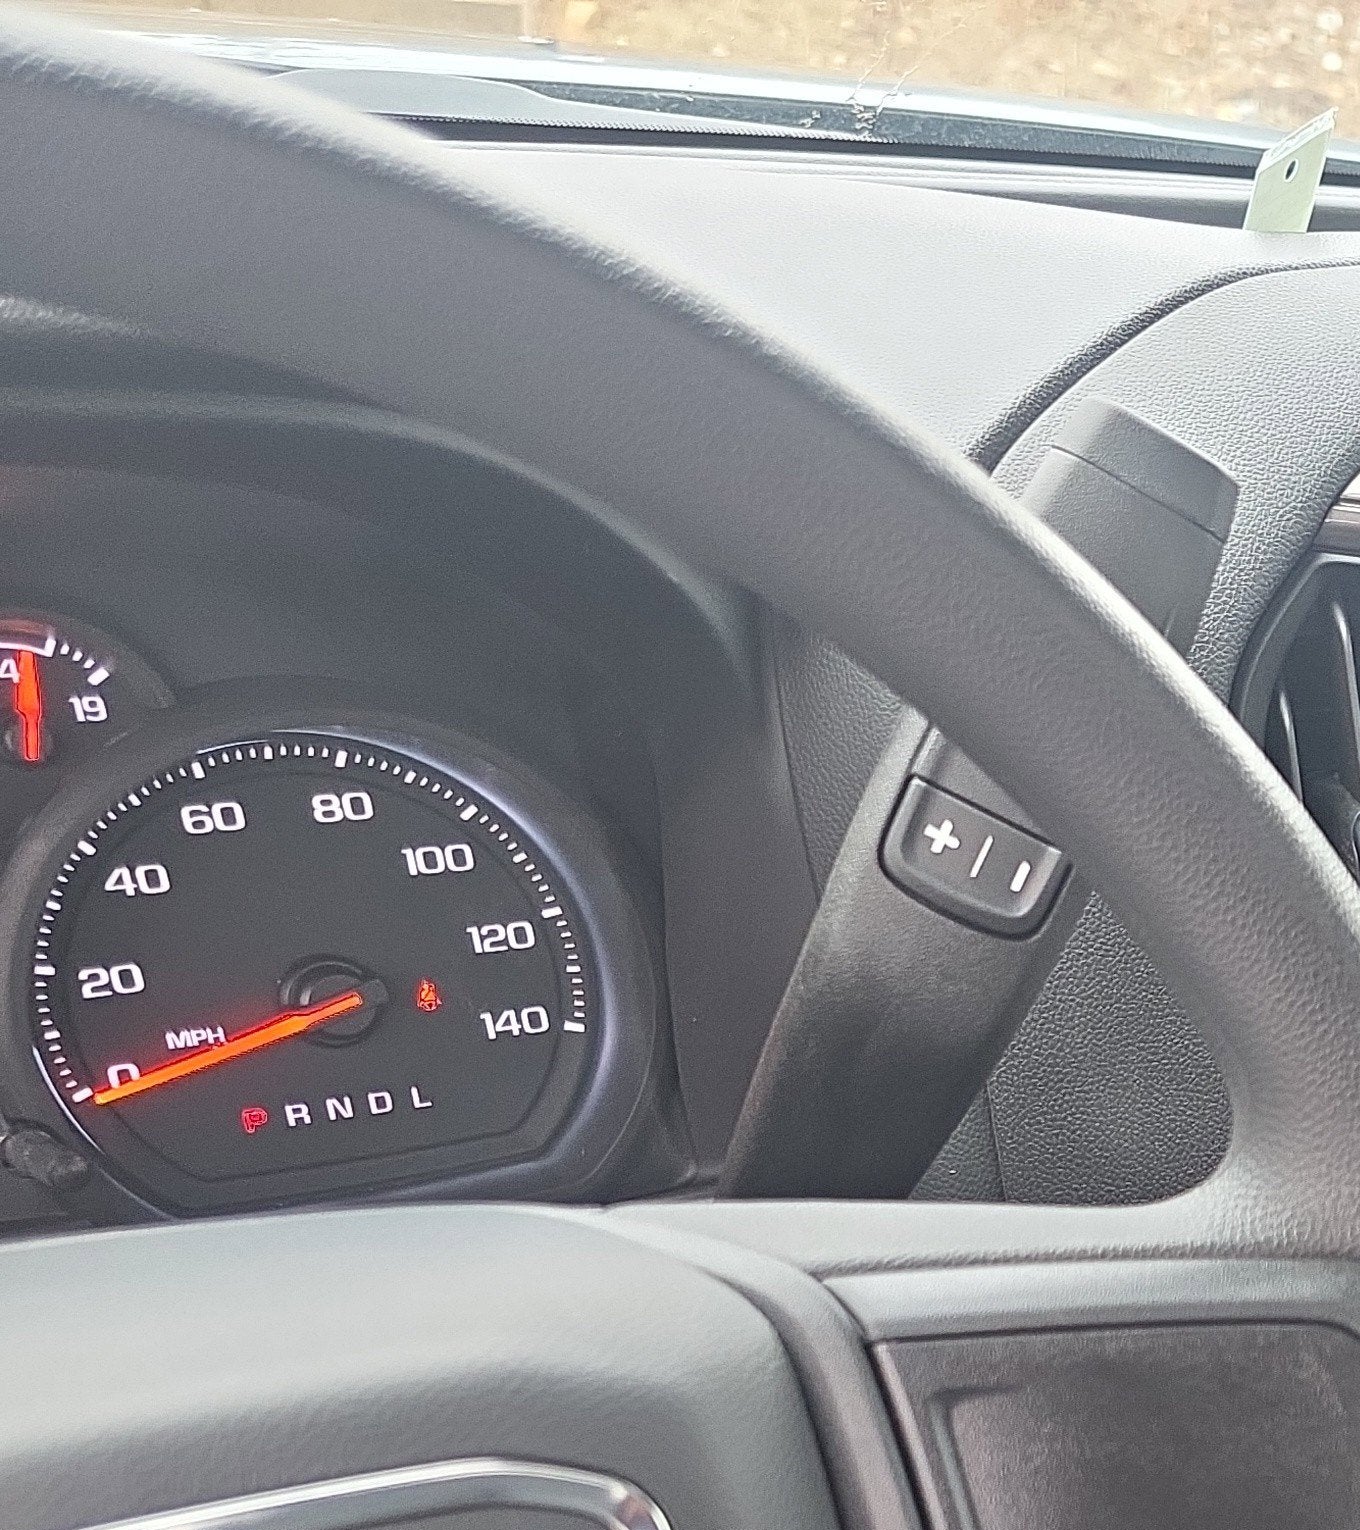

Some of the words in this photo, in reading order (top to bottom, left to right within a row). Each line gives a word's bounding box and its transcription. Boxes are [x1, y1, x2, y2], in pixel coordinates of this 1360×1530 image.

[68, 695, 108, 722] 19
[180, 801, 247, 836] 60
[311, 791, 375, 825] 80
[401, 842, 475, 877] 100
[103, 863, 172, 897] 40
[465, 920, 536, 954] 120
[77, 963, 146, 999] 20
[165, 1026, 226, 1050] MPH
[480, 1005, 550, 1040] 140
[242, 1106, 268, 1134] P
[284, 1102, 313, 1128] R
[325, 1095, 354, 1121] N
[367, 1091, 393, 1115] D
[410, 1085, 433, 1109] L
